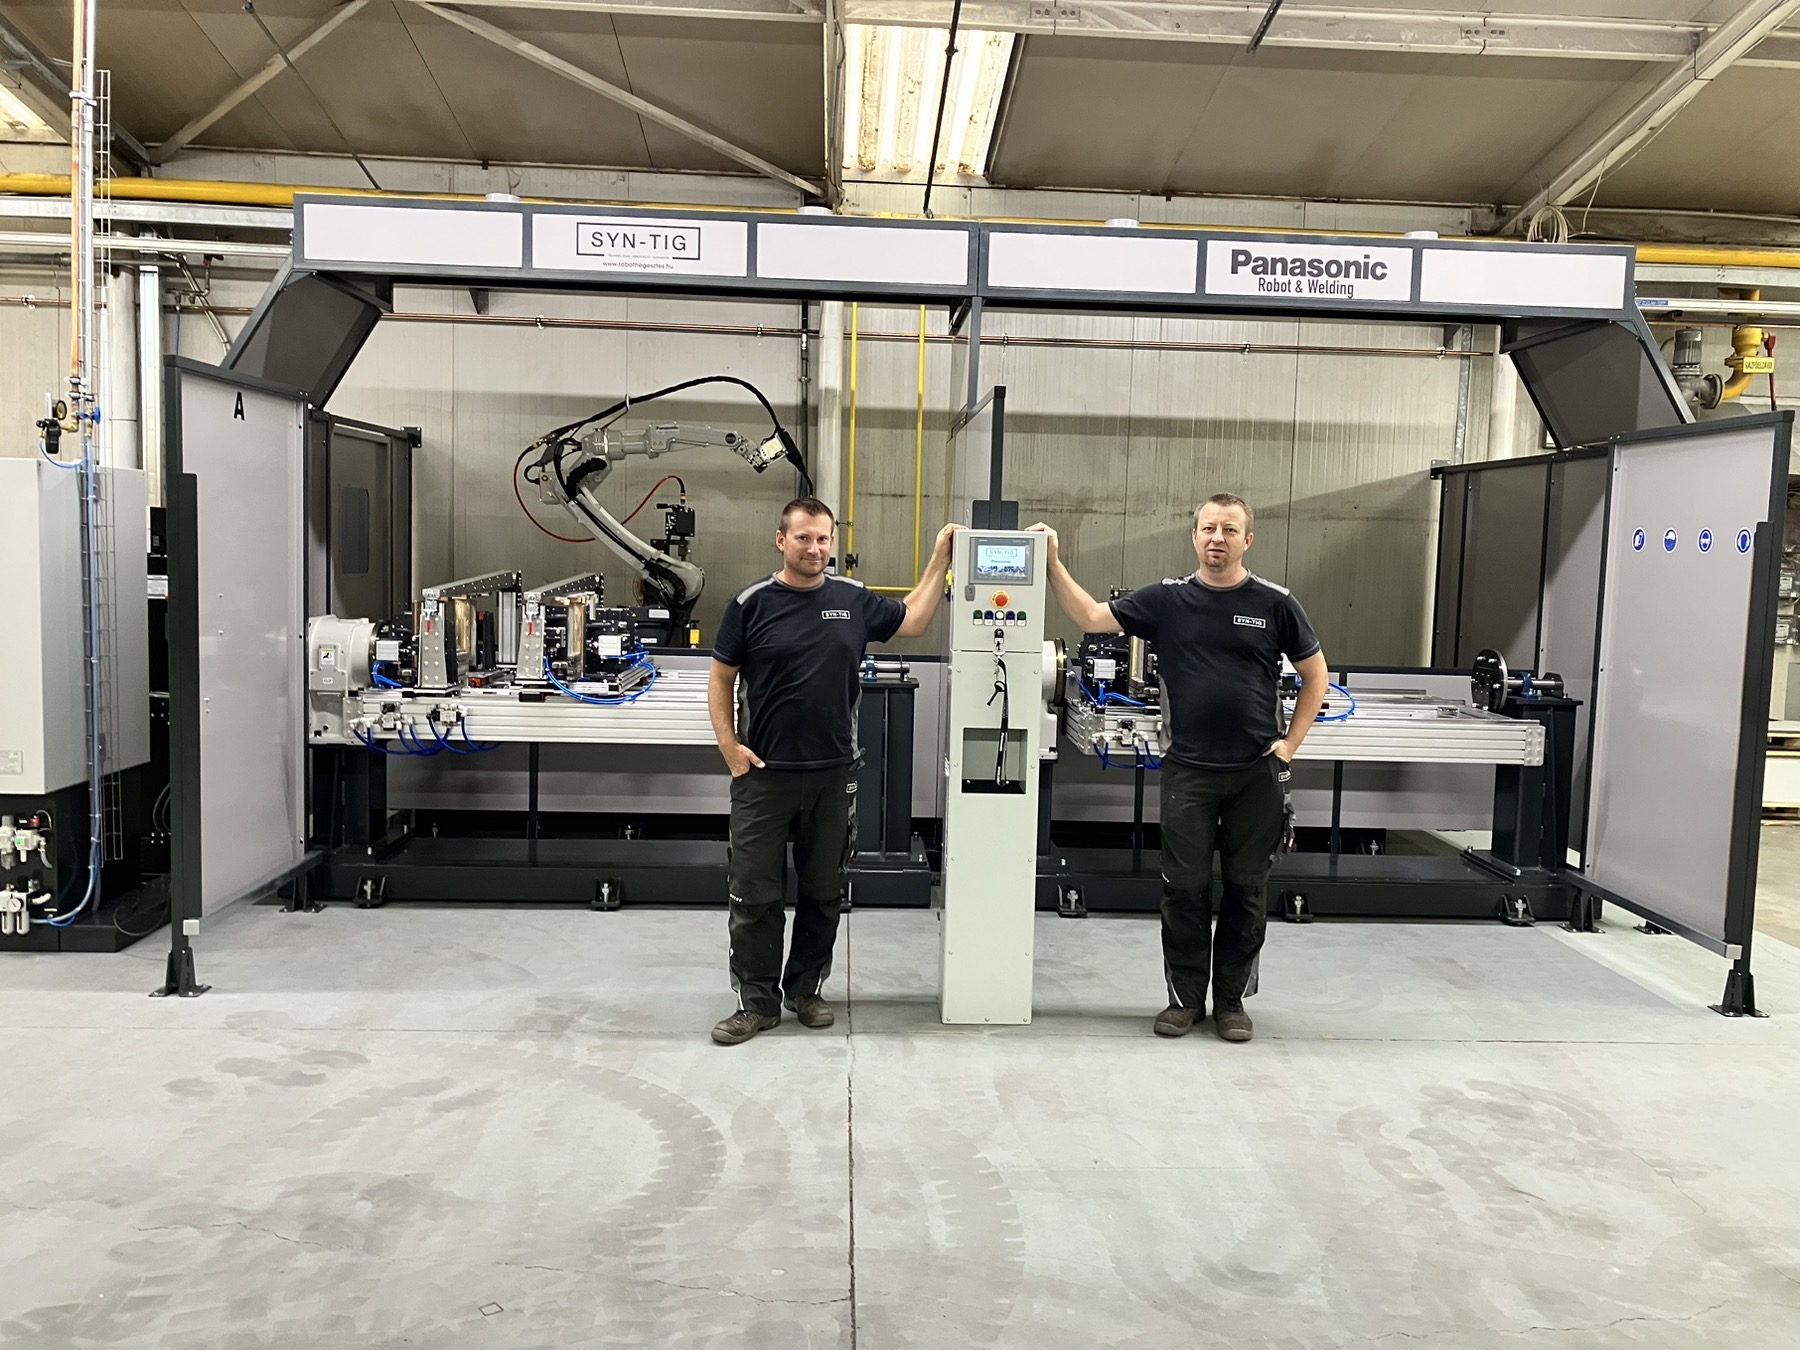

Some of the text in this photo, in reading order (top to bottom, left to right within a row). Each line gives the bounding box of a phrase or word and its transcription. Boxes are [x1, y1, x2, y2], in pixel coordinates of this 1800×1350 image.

[591, 231, 687, 251] SYN-TIG
[1231, 249, 1388, 281] Panasonic
[1258, 277, 1354, 298] Robot & Welding
[234, 391, 245, 421] A
